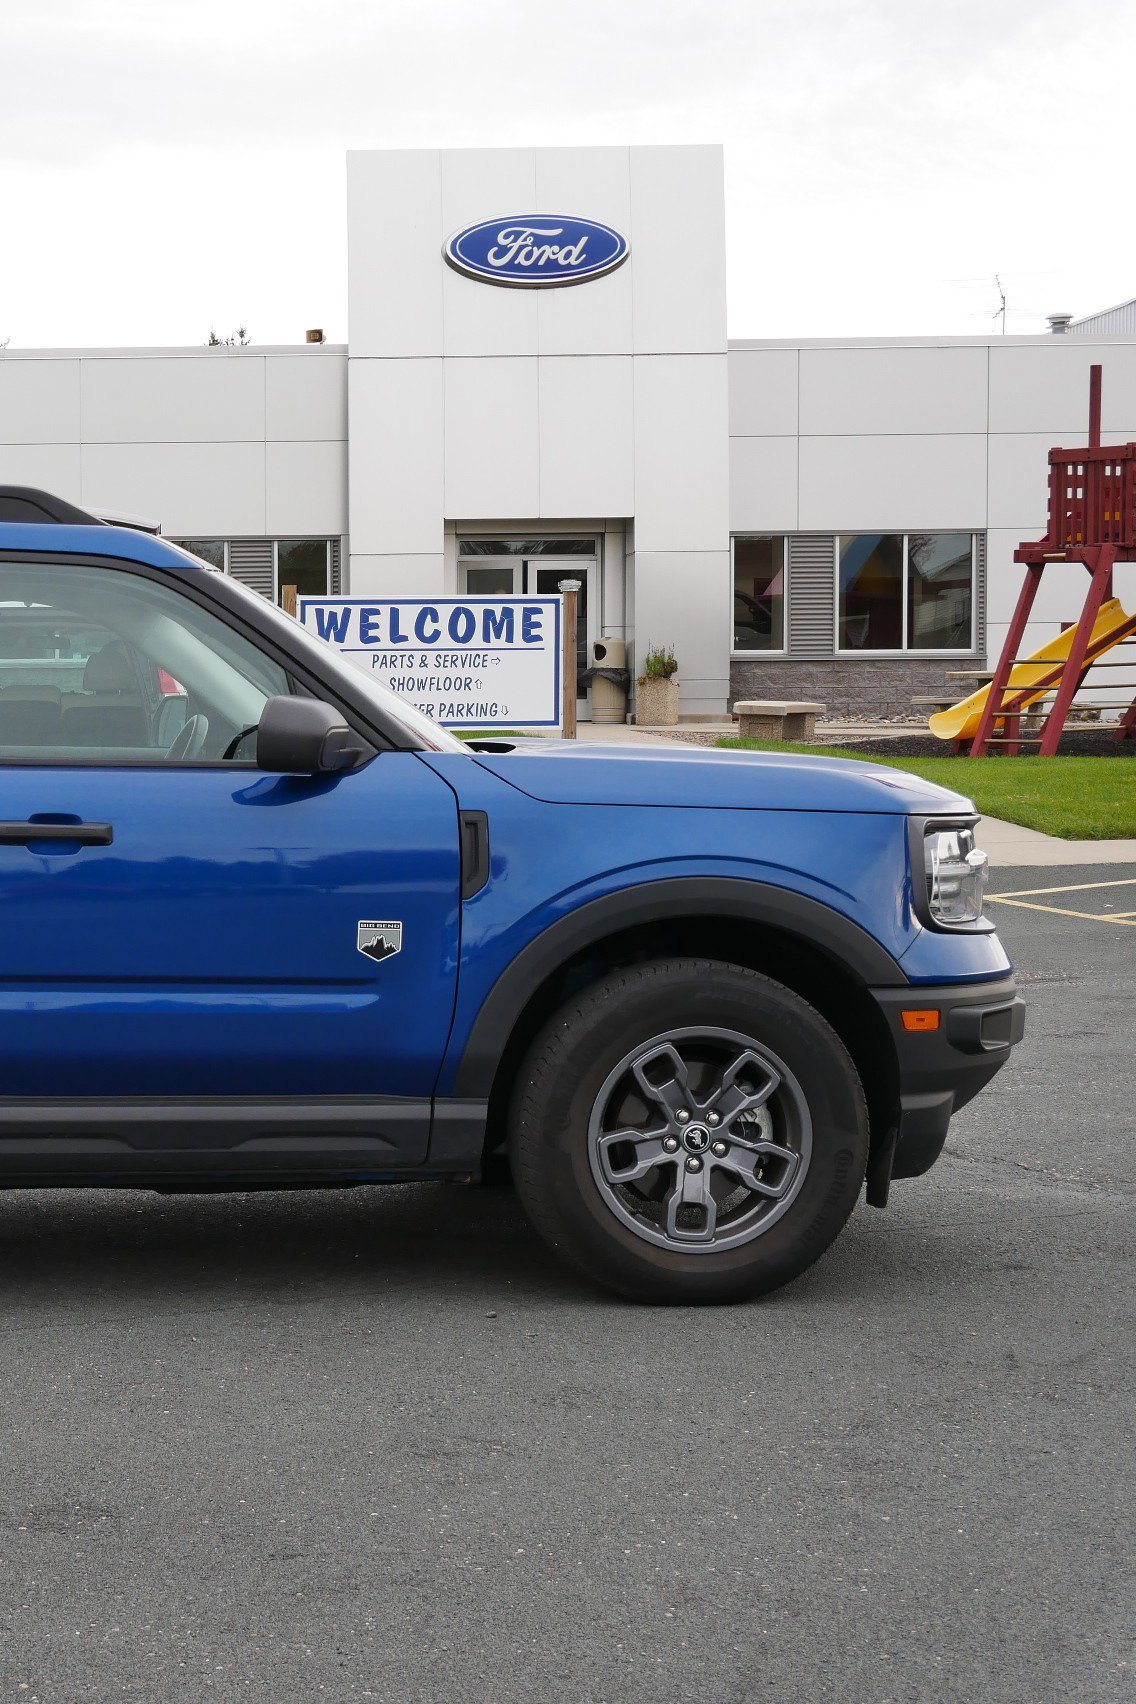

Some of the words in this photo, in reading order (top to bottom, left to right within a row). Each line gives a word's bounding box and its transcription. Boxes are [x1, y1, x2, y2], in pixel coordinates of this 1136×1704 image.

[487, 226, 589, 267] Ford
[314, 606, 544, 645] WELCOME
[372, 654, 415, 669] PARTS
[419, 654, 429, 668] &
[434, 653, 489, 668] SERVICE
[389, 676, 473, 691] SHOWFLOOR
[439, 702, 498, 717] PARKING
